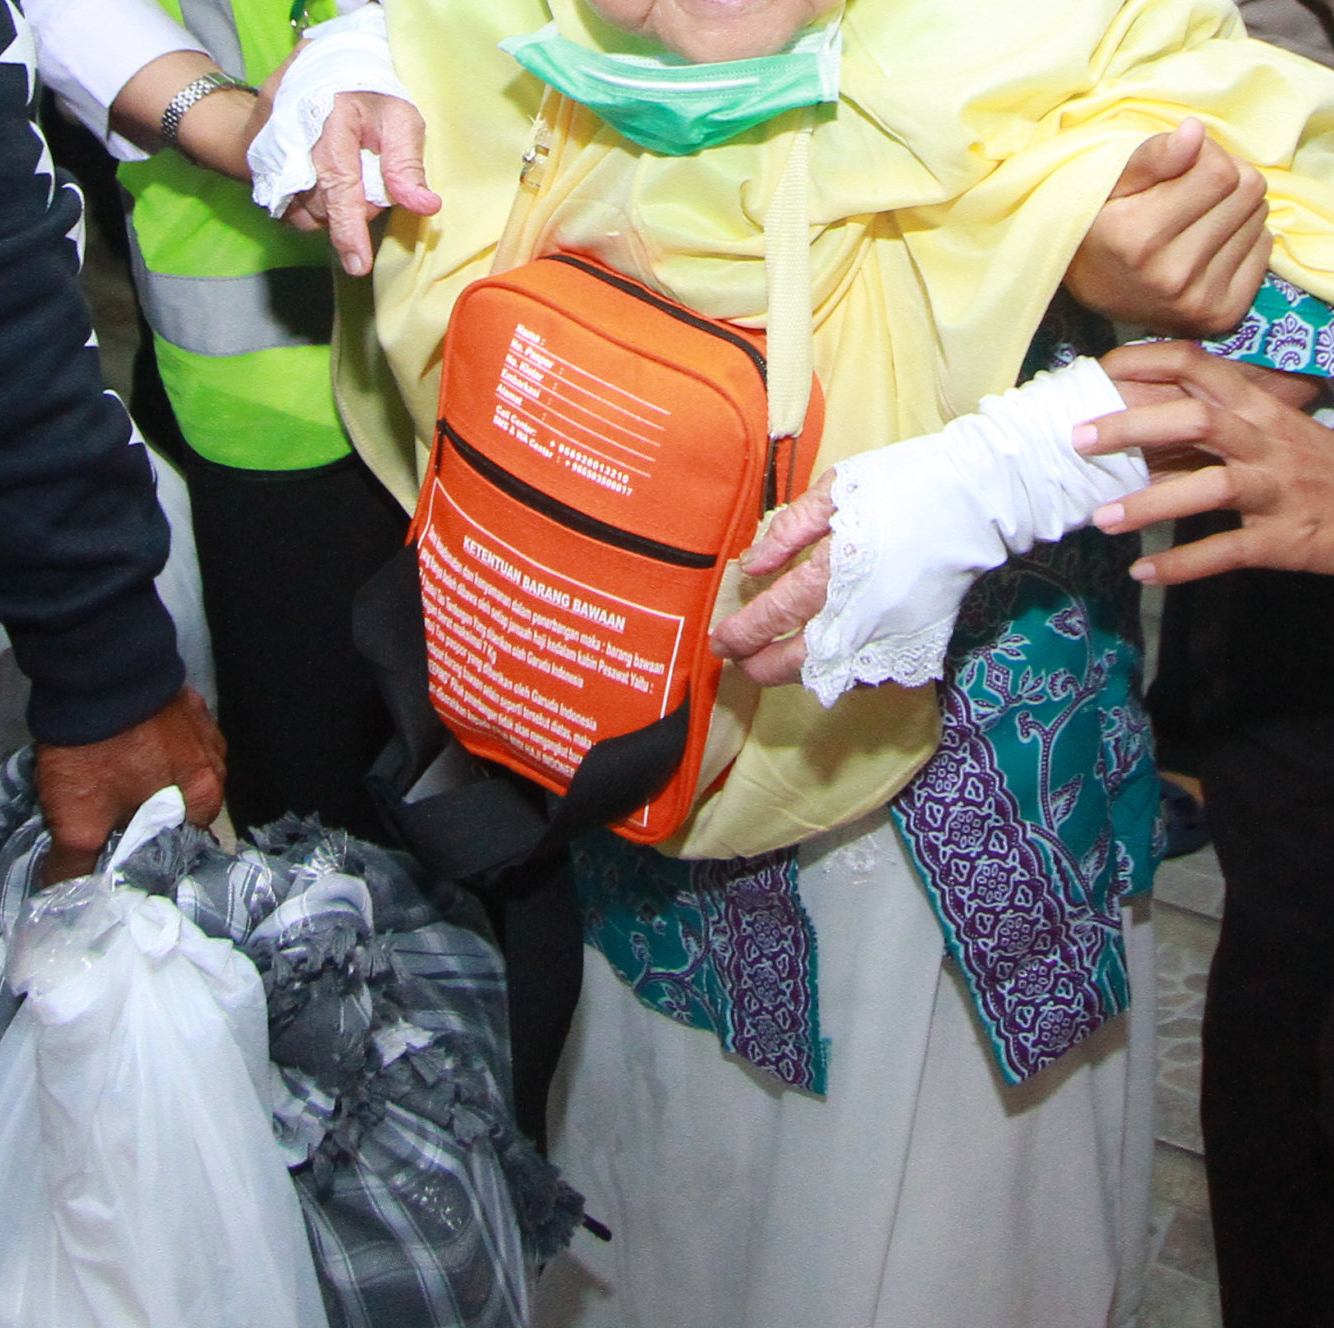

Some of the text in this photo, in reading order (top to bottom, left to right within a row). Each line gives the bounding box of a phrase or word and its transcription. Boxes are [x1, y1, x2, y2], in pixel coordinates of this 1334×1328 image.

[500, 368, 541, 399] Embarkasi
[463, 535, 523, 586] KETENTUAN
[522, 574, 571, 609] BARANG
[572, 598, 626, 632] BAWAAN
[487, 643, 497, 665] Kg
[511, 645, 527, 662] oleh
[526, 651, 551, 673] Garuda
[551, 662, 584, 689] Indonesia
[531, 612, 580, 642] penerbangan
[580, 632, 601, 652] maka
[605, 641, 633, 668] barang
[633, 652, 665, 675] bawaan
[532, 629, 547, 651] haji
[576, 650, 598, 671] kabin
[597, 658, 630, 685] Pesawat
[630, 671, 650, 693] Yaitu
[513, 682, 531, 699] oleh
[531, 688, 559, 714] Garuda
[559, 702, 597, 732] Indonesia
[522, 706, 551, 731] tersebut
[572, 732, 592, 751] maka
